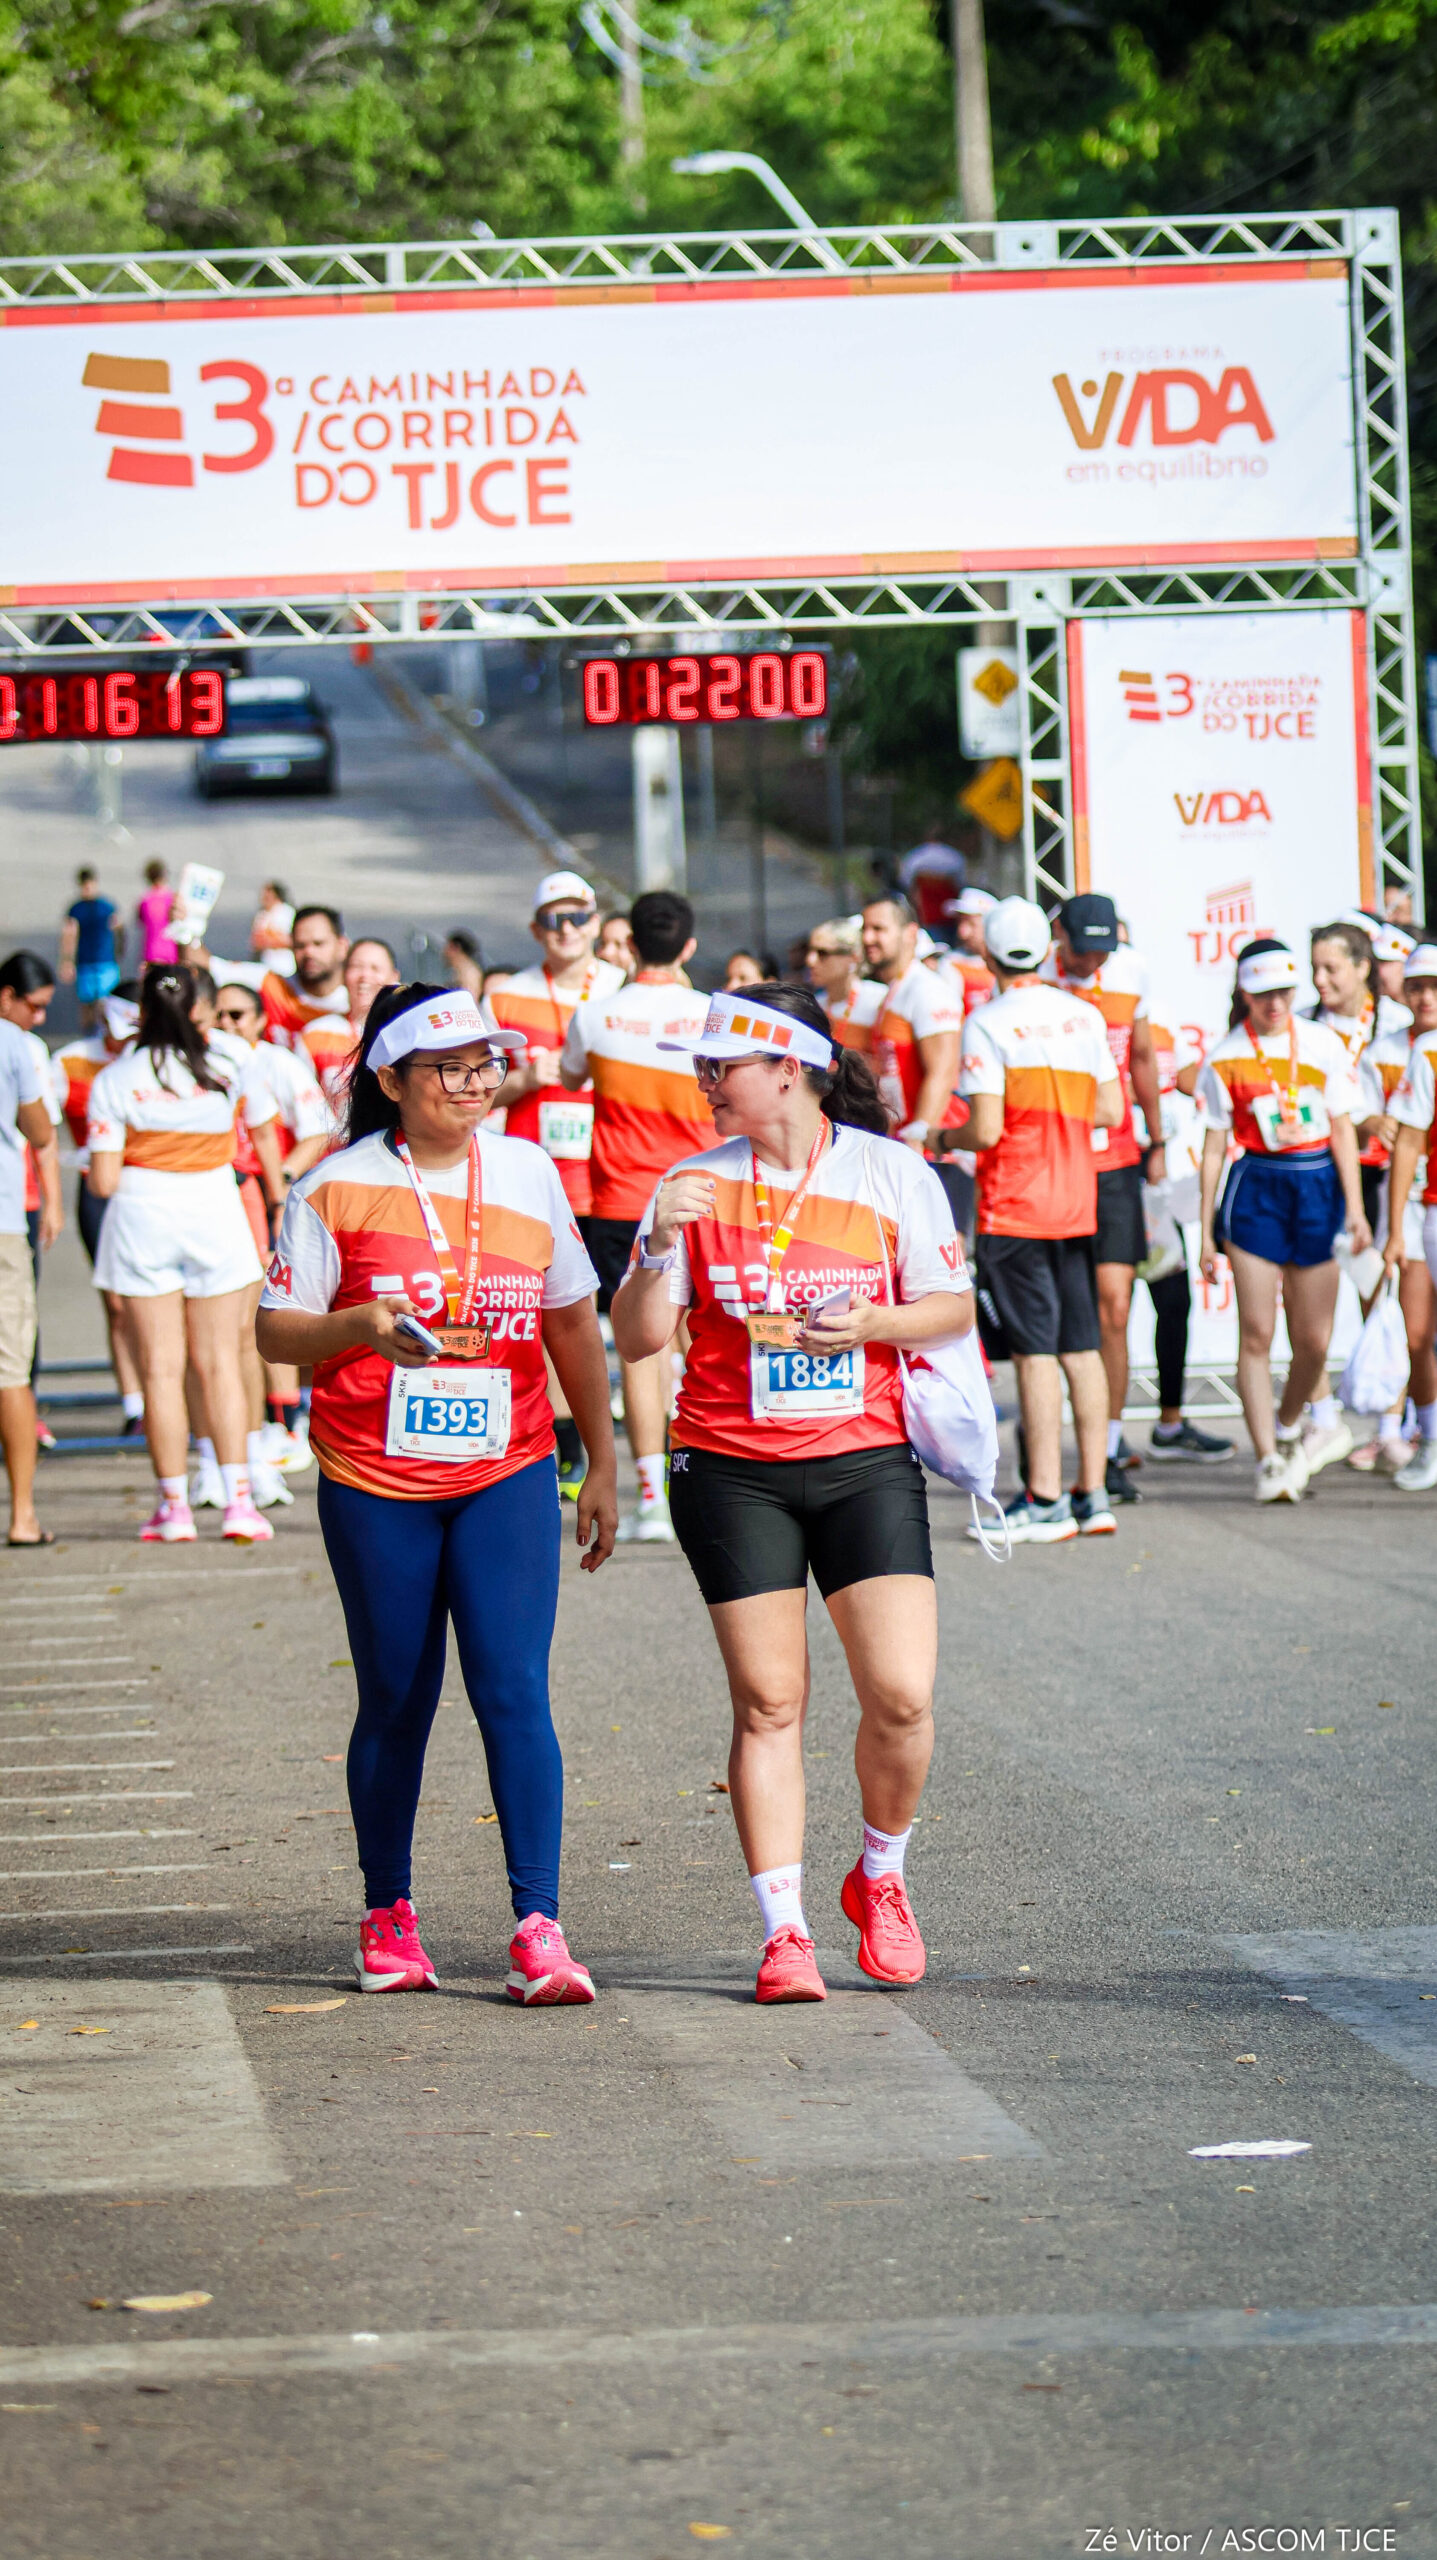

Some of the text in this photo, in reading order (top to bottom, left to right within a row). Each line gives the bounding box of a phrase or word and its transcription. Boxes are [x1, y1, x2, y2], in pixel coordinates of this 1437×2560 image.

[310, 366, 587, 405] CAMINHADA
[1052, 366, 1276, 450] VIDA
[292, 407, 580, 454] /CORRIDA
[1066, 461, 1111, 483] em
[295, 458, 573, 530] DO TJCE
[1243, 711, 1316, 741] TJCE
[1173, 789, 1271, 826] VIDA
[477, 1274, 544, 1291] MINHADA
[786, 1267, 884, 1285] CAMINHADA
[474, 1290, 542, 1310] ORRIDA
[483, 1310, 537, 1341] TJCE
[771, 1353, 854, 1388] 1884
[398, 1379, 407, 1398] 5KM
[409, 1398, 487, 1434] 1393
